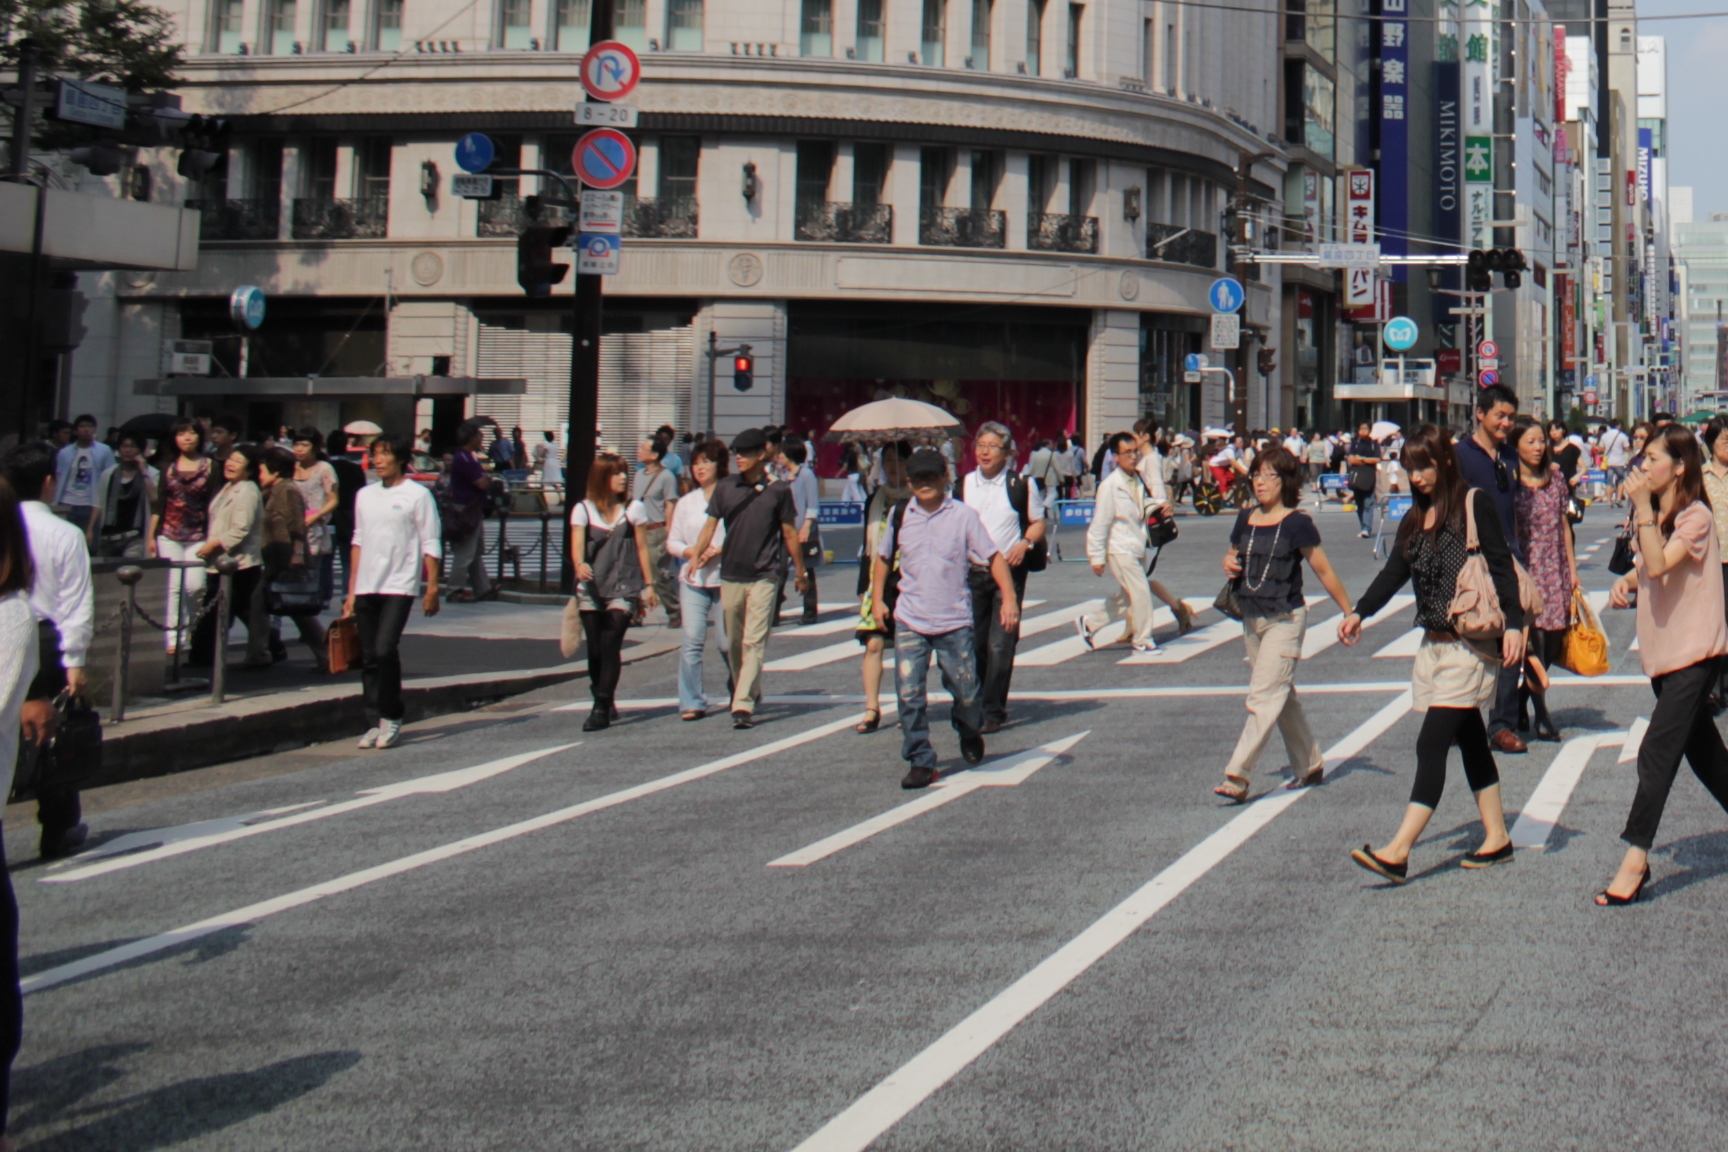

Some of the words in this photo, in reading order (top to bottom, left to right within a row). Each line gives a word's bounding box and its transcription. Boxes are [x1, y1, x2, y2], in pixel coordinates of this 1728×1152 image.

[1440, 101, 1456, 211] MIKIMOTO
[1466, 143, 1489, 175] 本
[1637, 147, 1651, 201] MIZUHO
